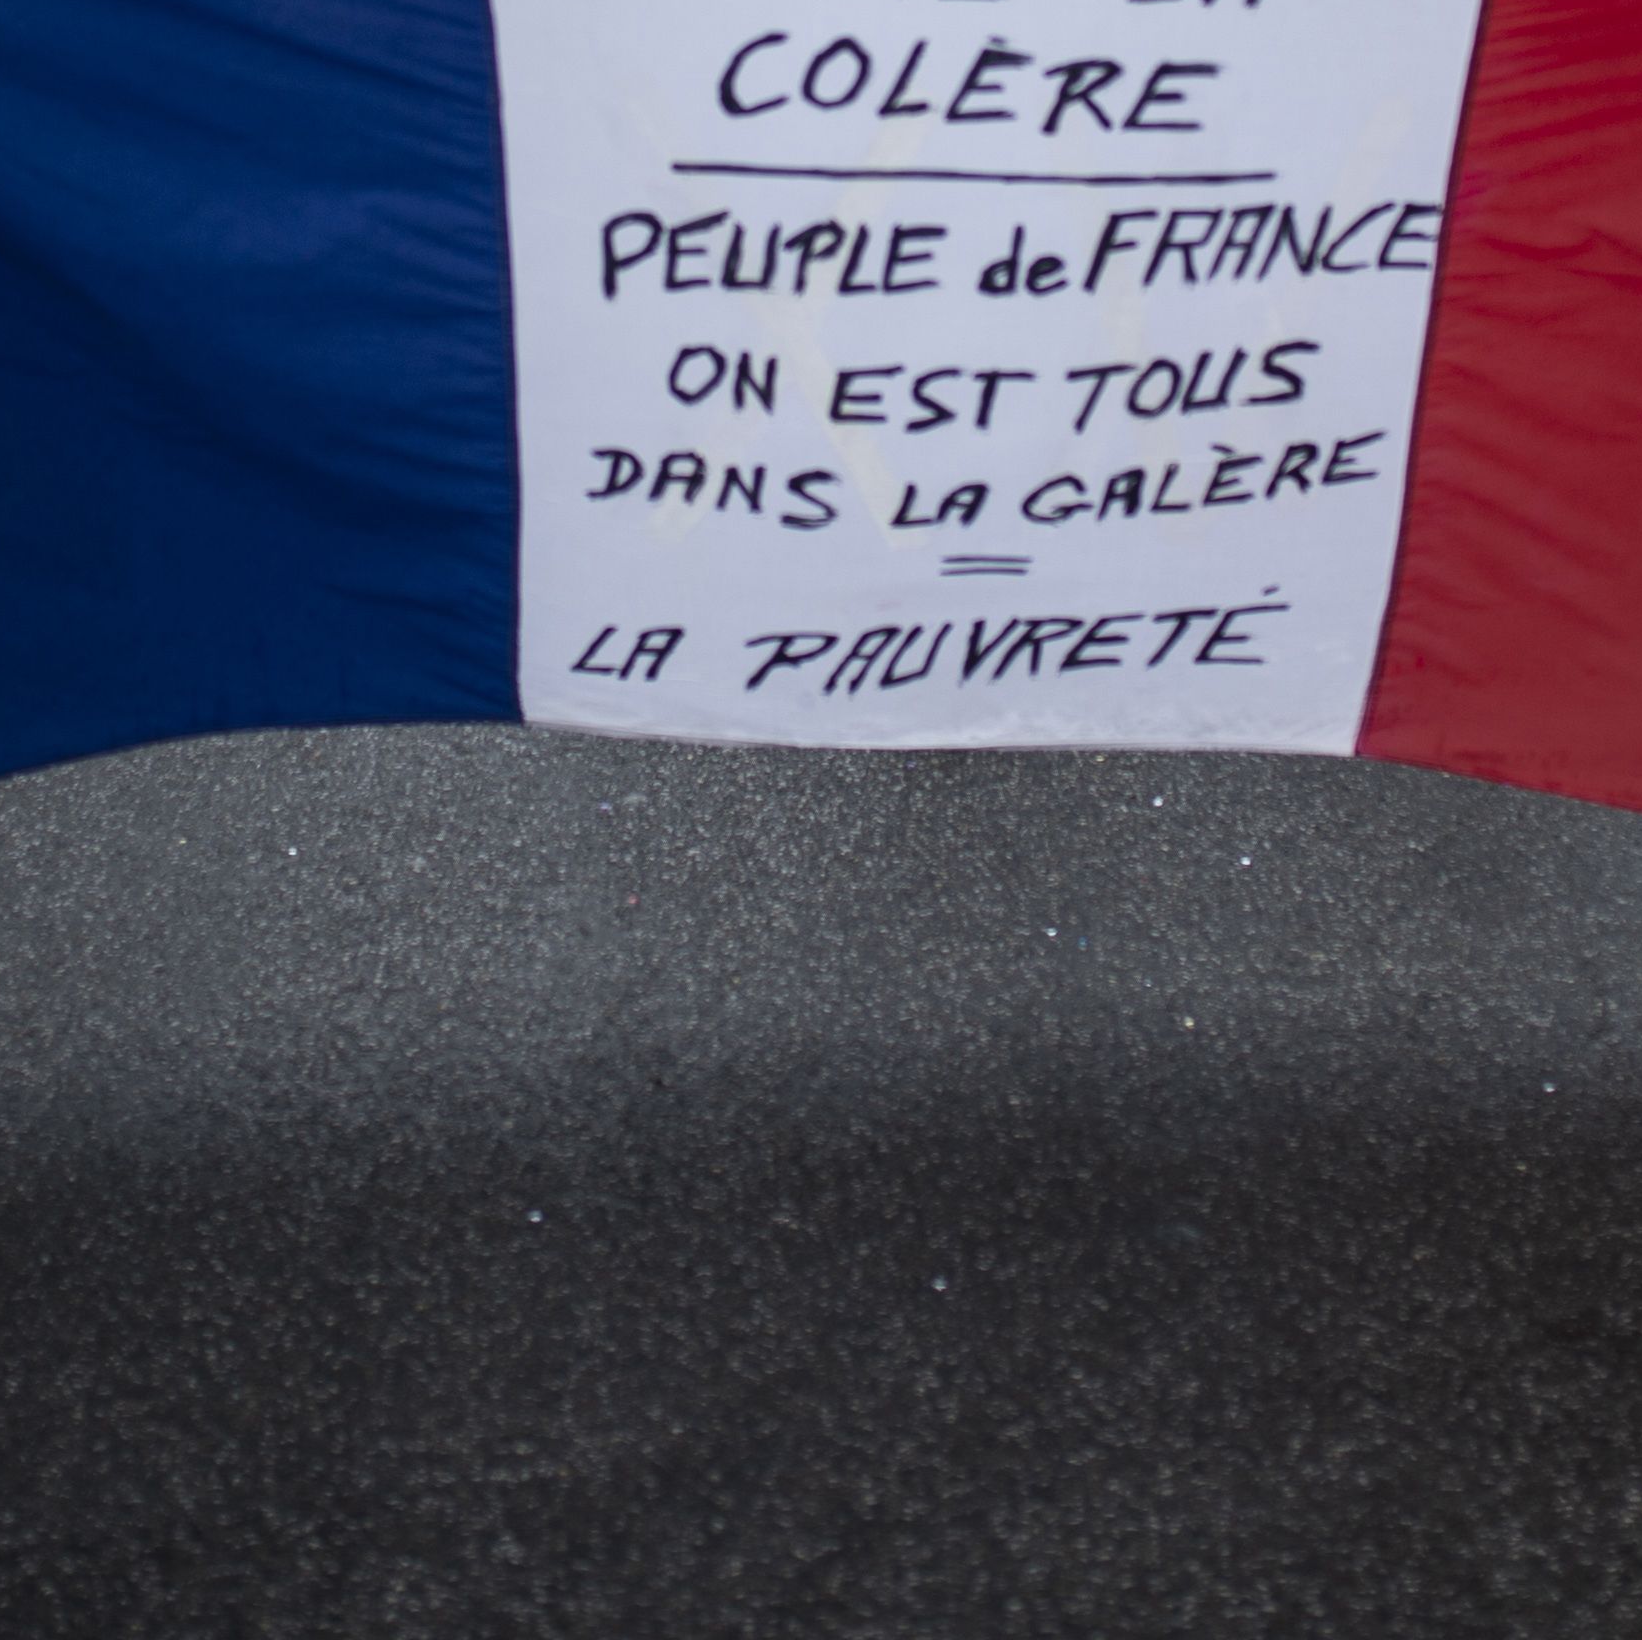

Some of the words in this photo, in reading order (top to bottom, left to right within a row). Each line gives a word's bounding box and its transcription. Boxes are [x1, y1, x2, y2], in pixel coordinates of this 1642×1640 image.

[601, 211, 947, 300] PEUPLE
[977, 225, 1068, 297] de
[1082, 202, 1443, 293] FRANCE
[667, 345, 778, 413] ON
[828, 364, 1035, 433] EST
[1065, 339, 1321, 433] TOUS
[586, 448, 837, 530] DANS
[890, 482, 989, 529] LA
[1020, 431, 1387, 524] GALÈRE
[570, 625, 685, 682] LA
[745, 586, 1291, 695] PAUVRETÉ
